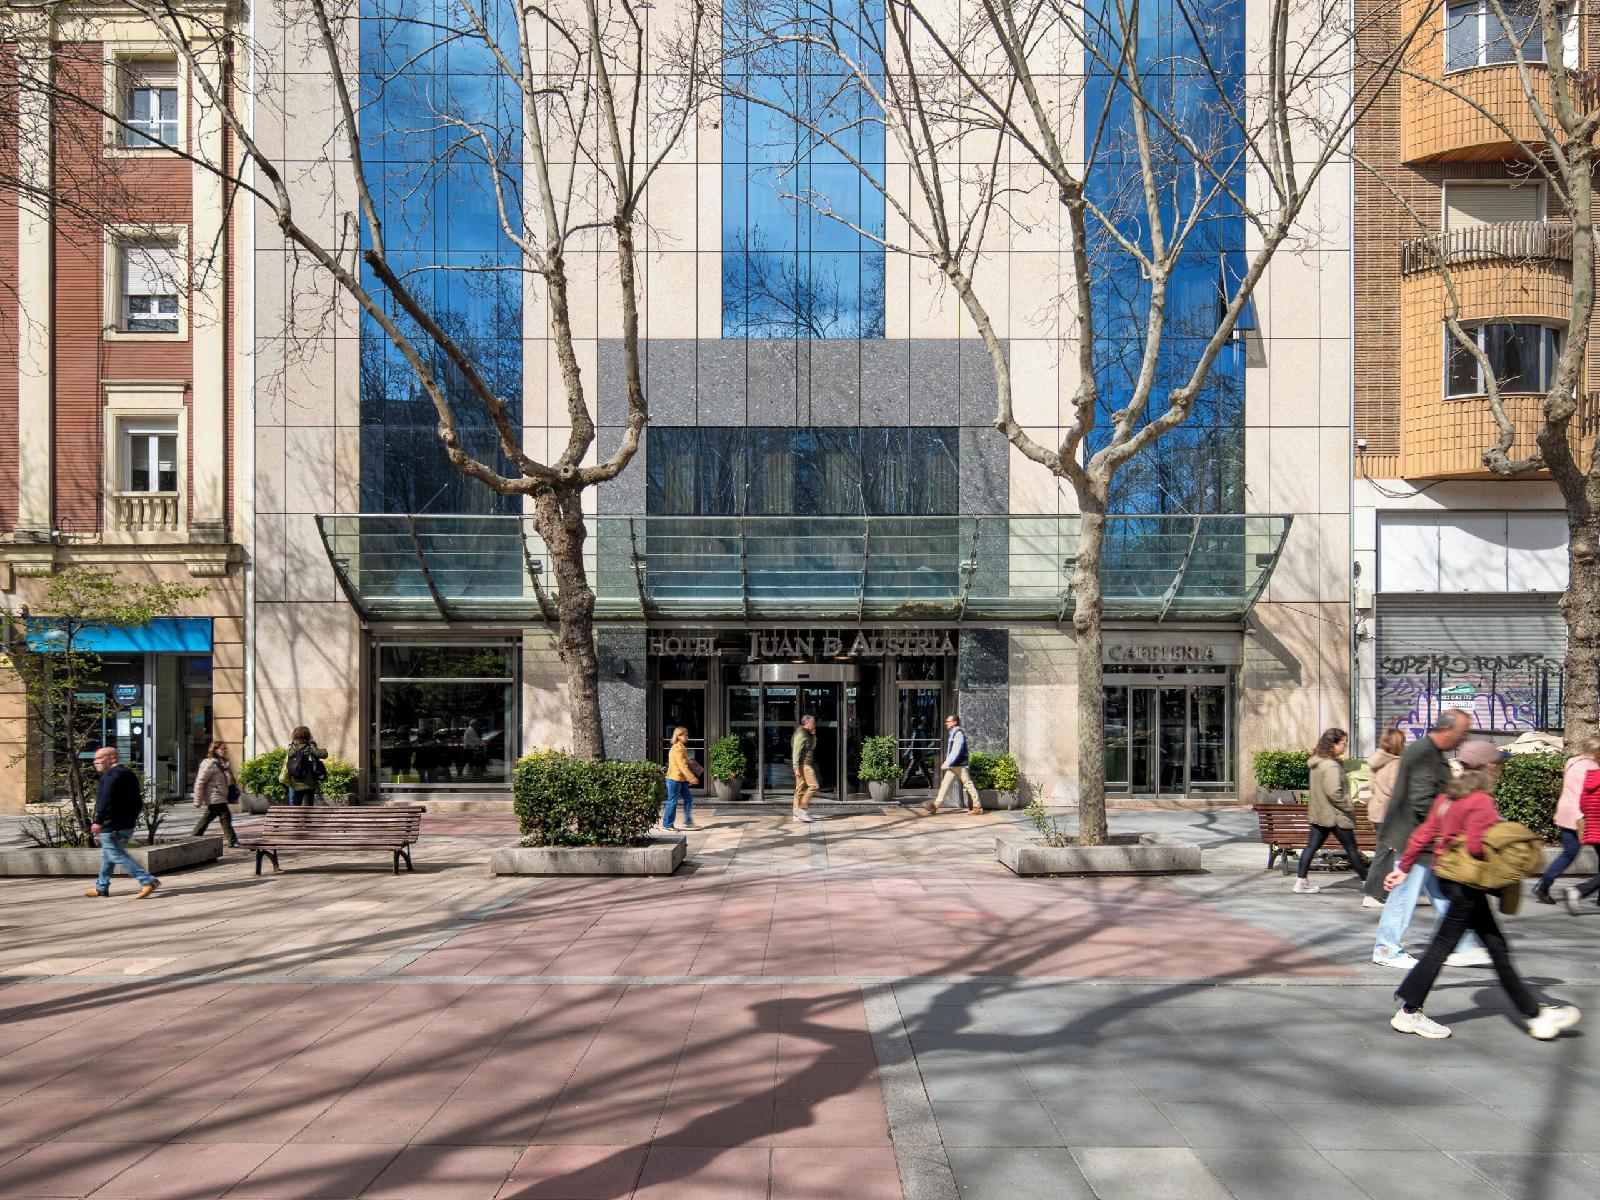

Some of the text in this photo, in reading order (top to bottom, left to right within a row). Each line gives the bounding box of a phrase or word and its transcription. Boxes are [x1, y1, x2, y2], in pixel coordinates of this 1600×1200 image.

[648, 636, 722, 657] HOTEL
[747, 631, 815, 662] JUAN
[847, 629, 957, 657] AUSTRIA
